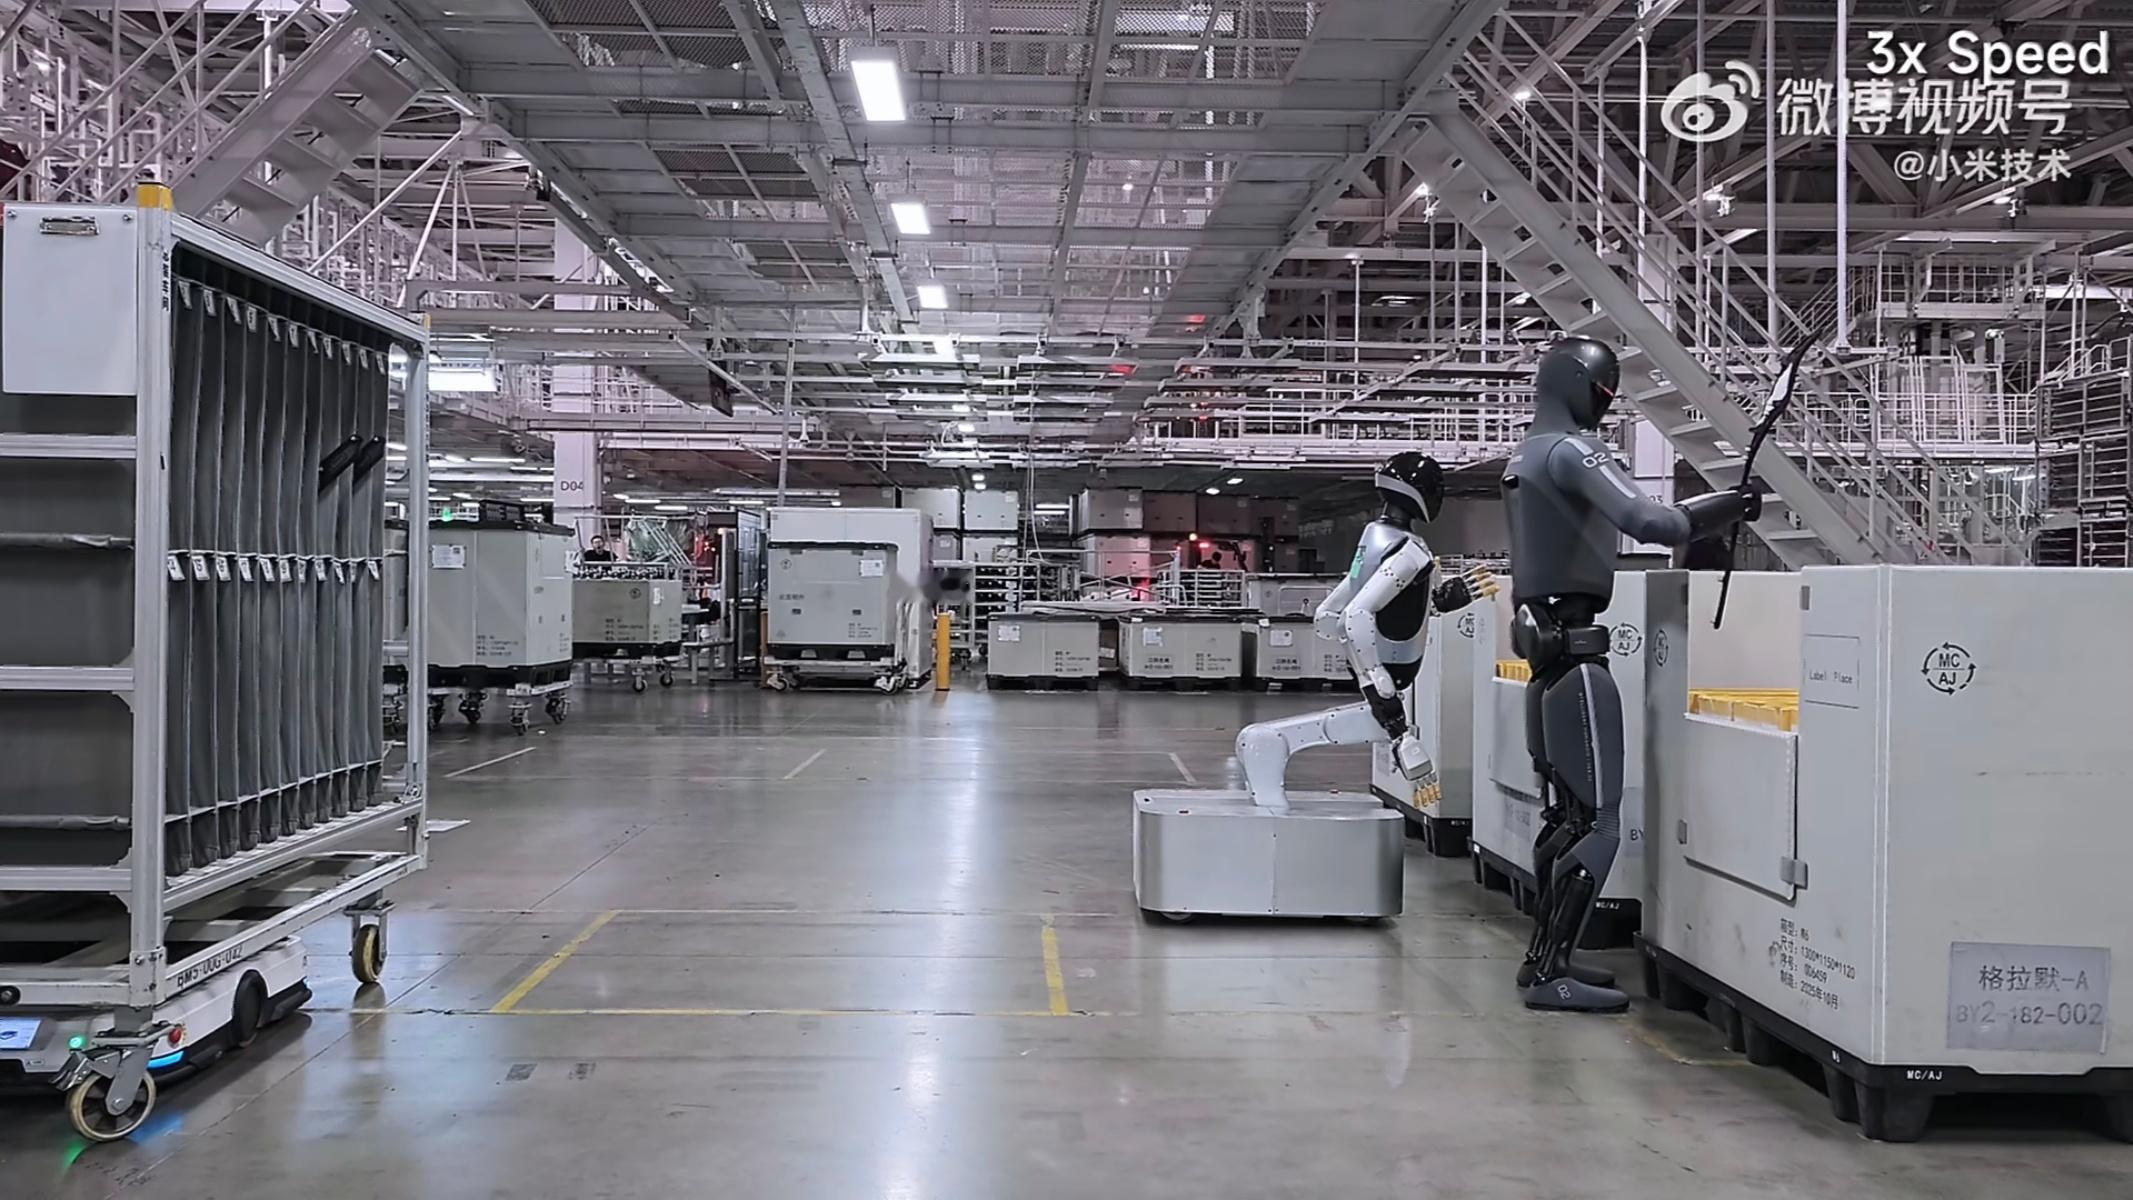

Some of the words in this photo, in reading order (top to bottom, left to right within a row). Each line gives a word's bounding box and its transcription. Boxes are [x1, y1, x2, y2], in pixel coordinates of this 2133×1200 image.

[1582, 452, 1609, 468] 02
[1939, 653, 1960, 668] MC
[1938, 671, 1956, 686] AJ
[1979, 964, 2090, 992] 格拉默-A
[1906, 1070, 1943, 1081] MC/AJ
